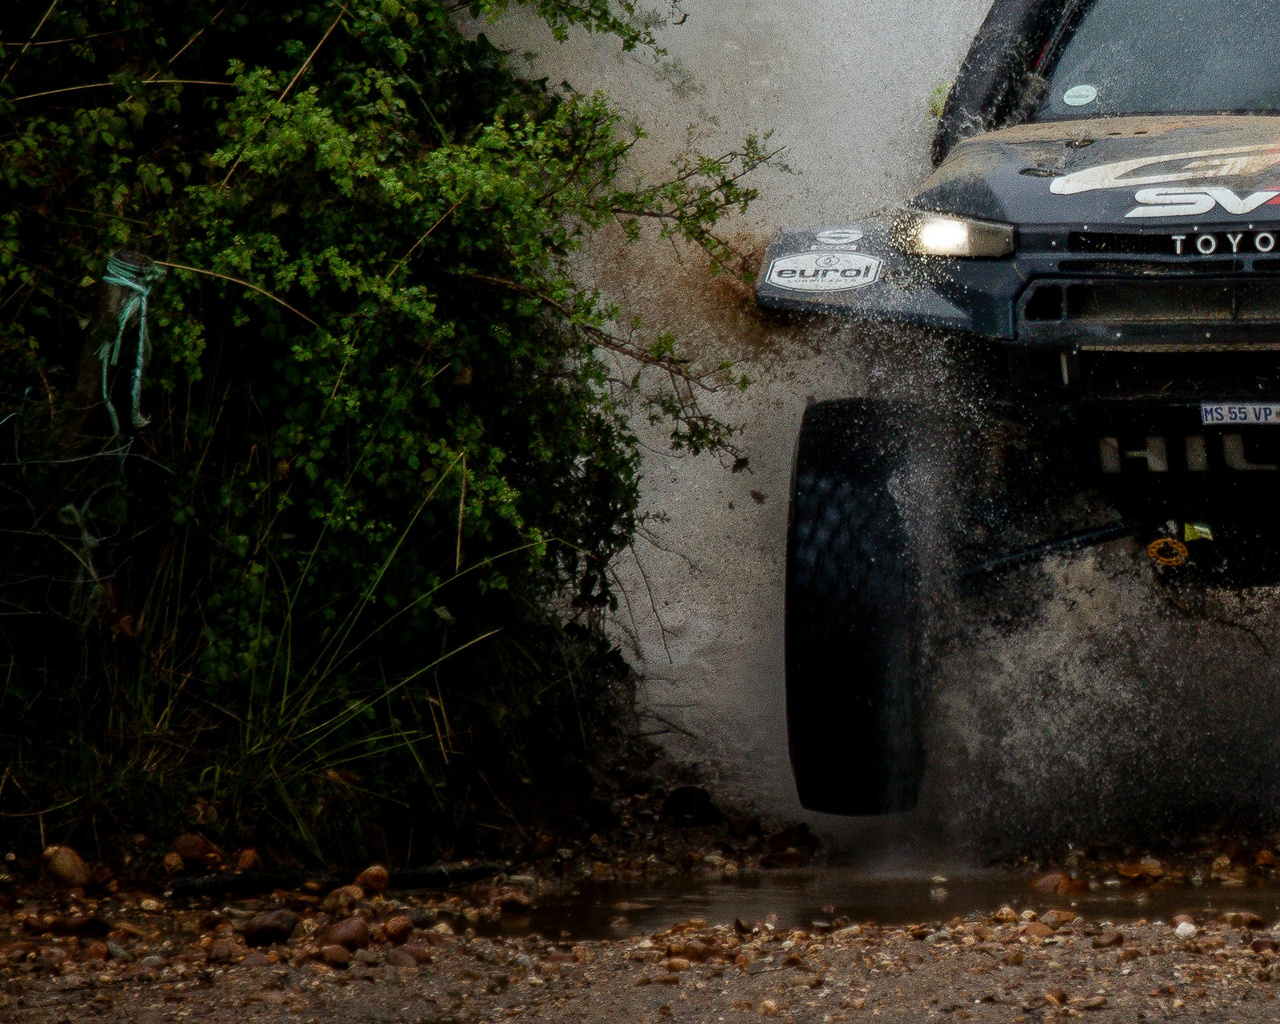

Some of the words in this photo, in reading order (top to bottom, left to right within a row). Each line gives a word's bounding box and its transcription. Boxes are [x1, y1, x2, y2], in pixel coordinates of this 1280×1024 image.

[776, 265, 871, 279] eurol
[1204, 406, 1224, 422] MS
[1228, 406, 1248, 422] 55
[1252, 406, 1273, 422] VP
